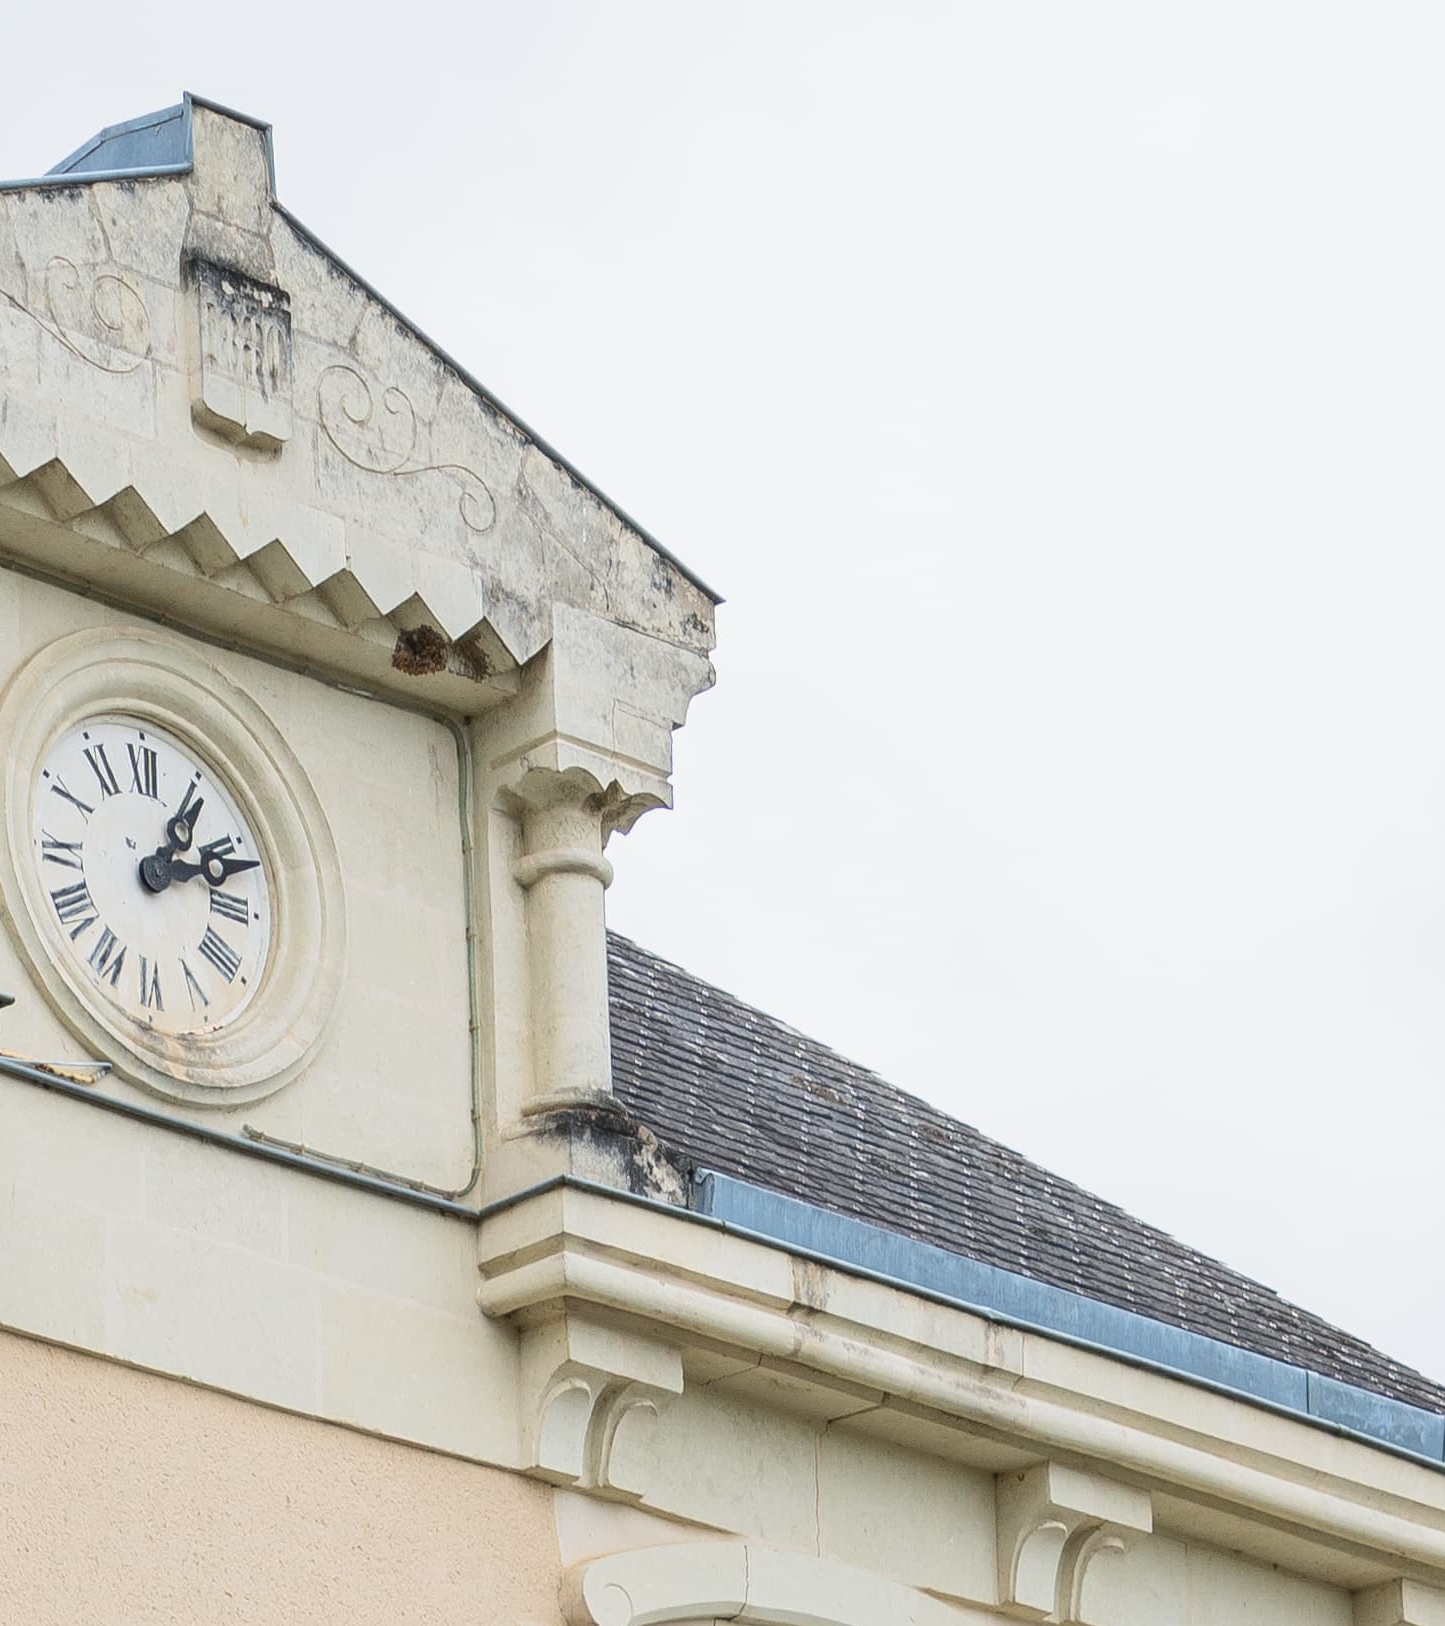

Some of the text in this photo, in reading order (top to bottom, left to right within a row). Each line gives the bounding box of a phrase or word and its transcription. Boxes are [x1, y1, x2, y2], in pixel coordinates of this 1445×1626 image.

[82, 744, 123, 801] XI
[125, 742, 159, 799] XII
[50, 774, 96, 824] X
[209, 887, 249, 928] III
